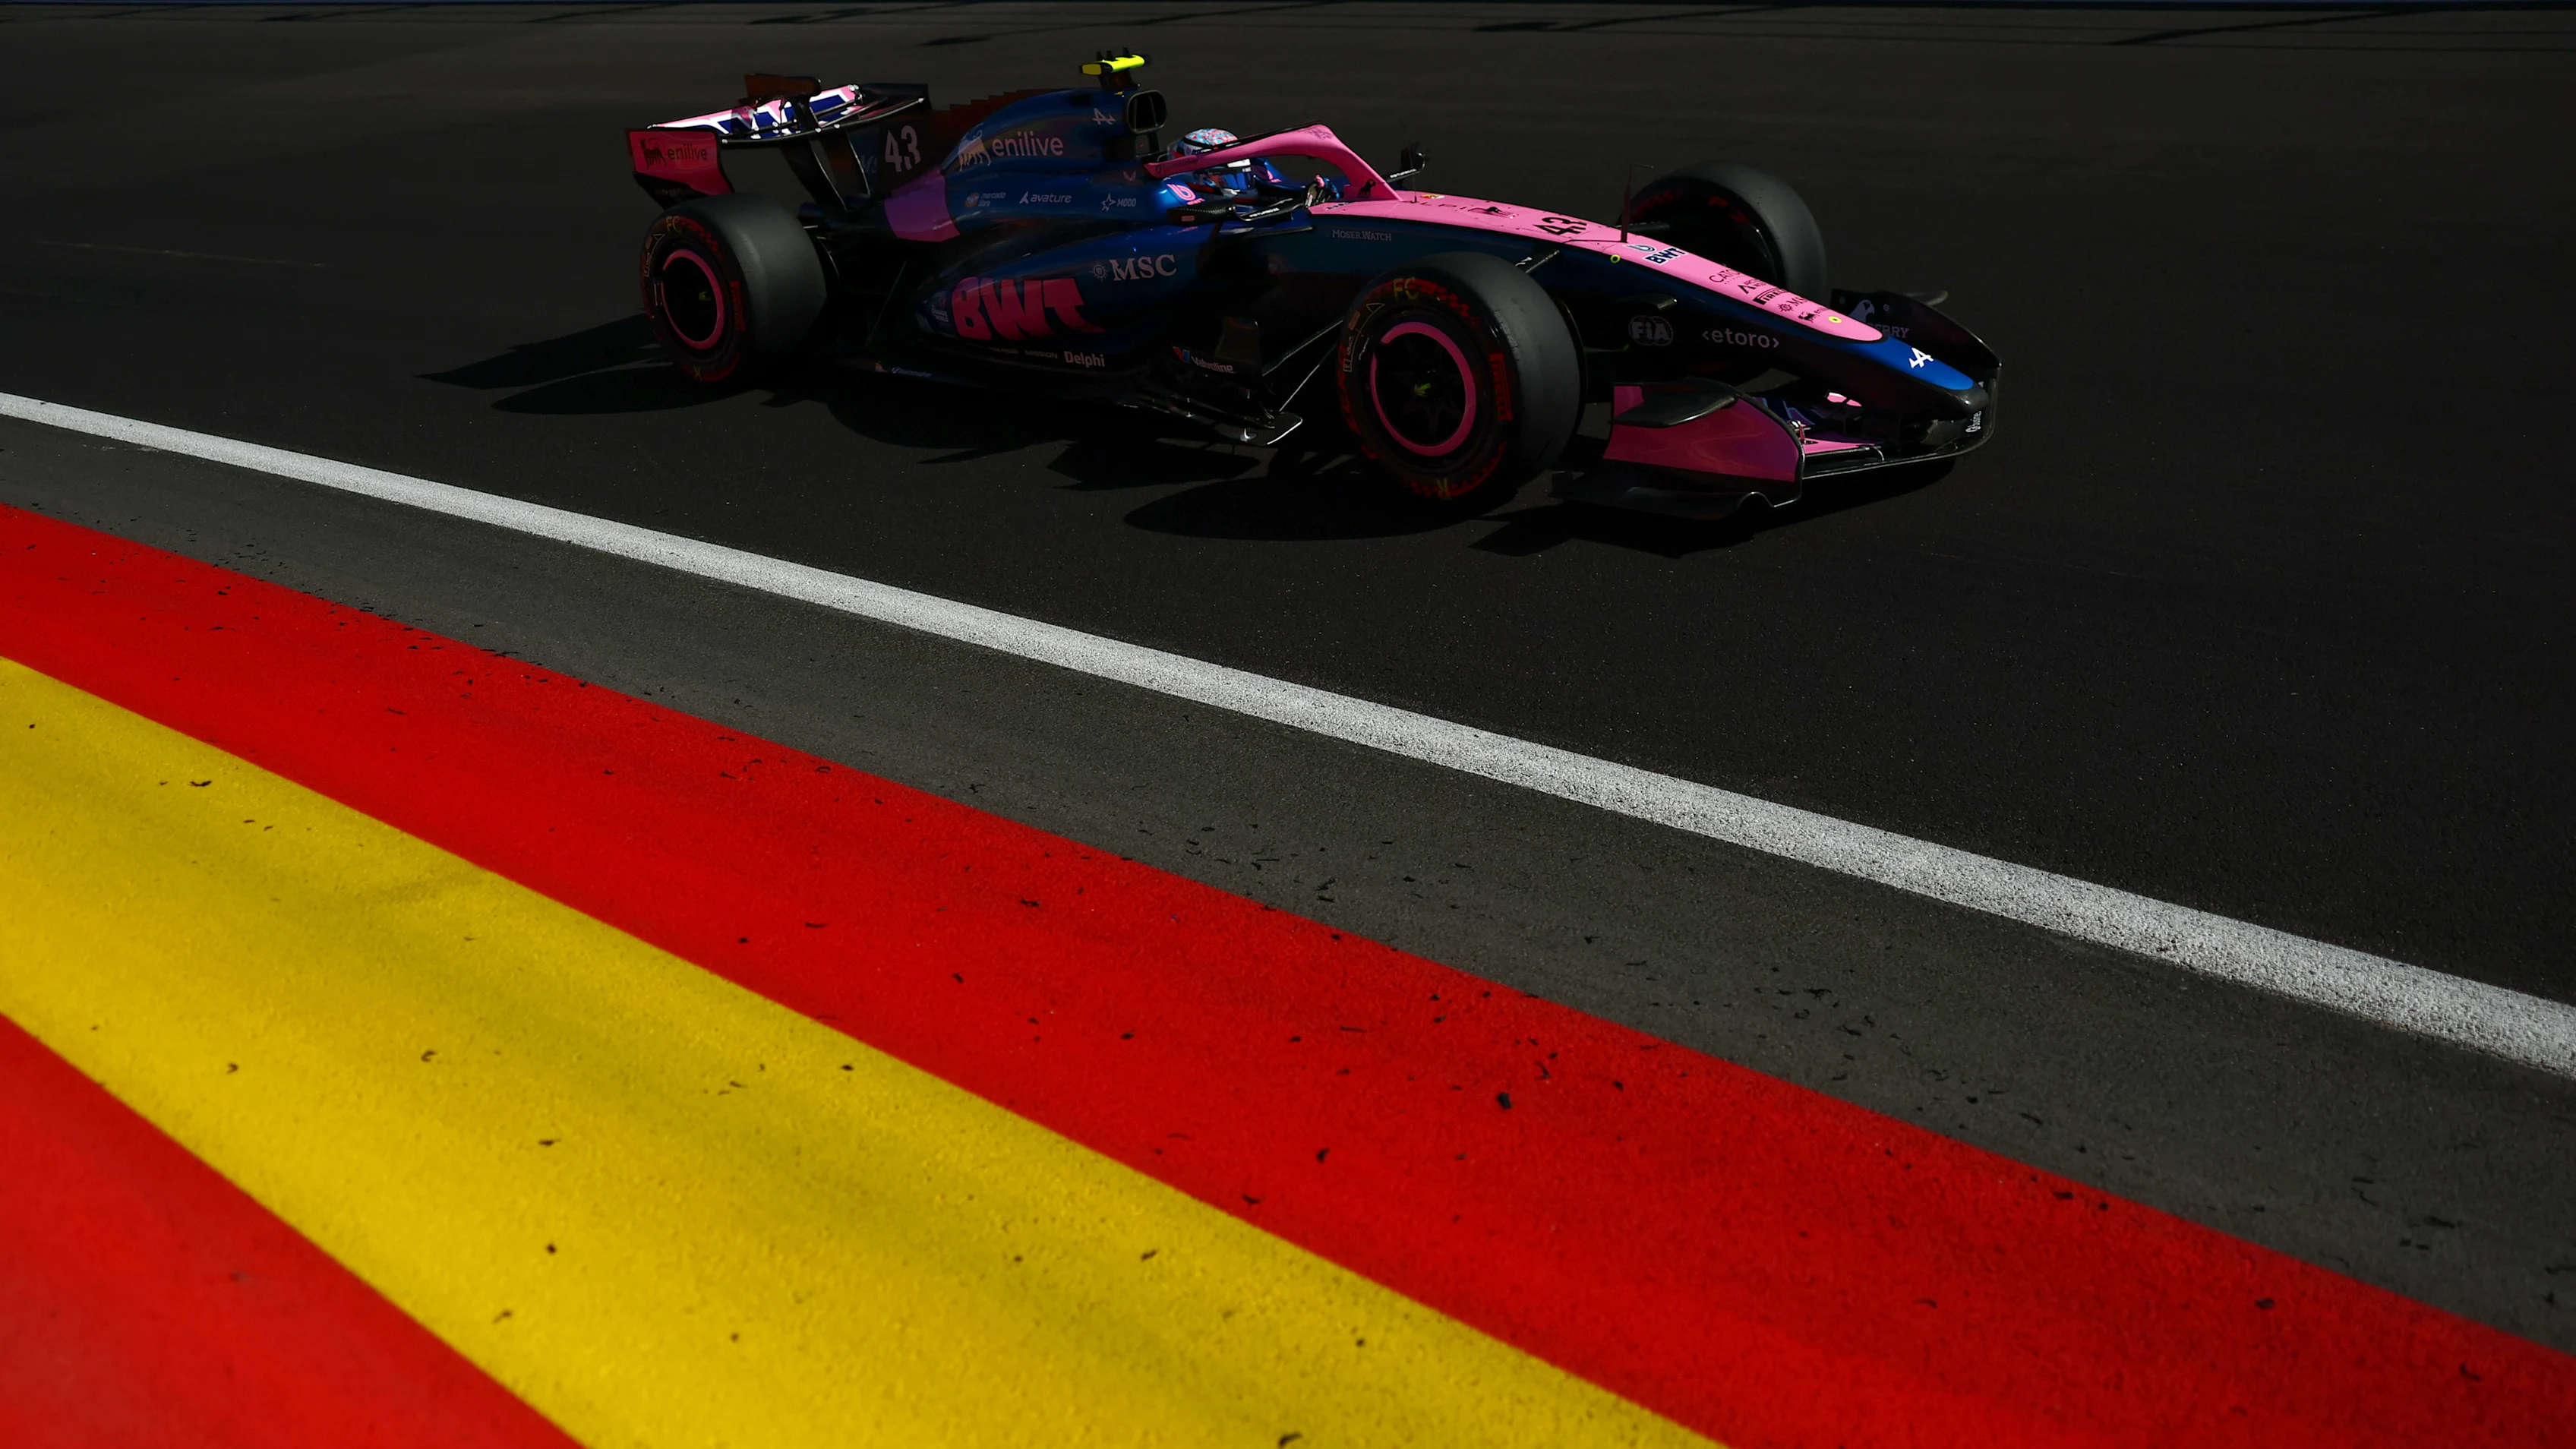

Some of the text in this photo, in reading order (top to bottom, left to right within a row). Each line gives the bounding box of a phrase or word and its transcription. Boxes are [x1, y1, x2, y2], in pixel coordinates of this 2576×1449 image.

[885, 125, 921, 172] 43
[993, 131, 1063, 156] enilive
[667, 145, 708, 161] enilive
[1031, 193, 1072, 204] avature
[1116, 198, 1137, 207] MODO
[1534, 216, 1587, 235] 43
[1645, 248, 1686, 264] BWT
[1109, 254, 1177, 282] MSC
[952, 276, 1106, 341] BWT
[1063, 351, 1106, 368] Delphi
[1191, 356, 1234, 374] Valvoline
